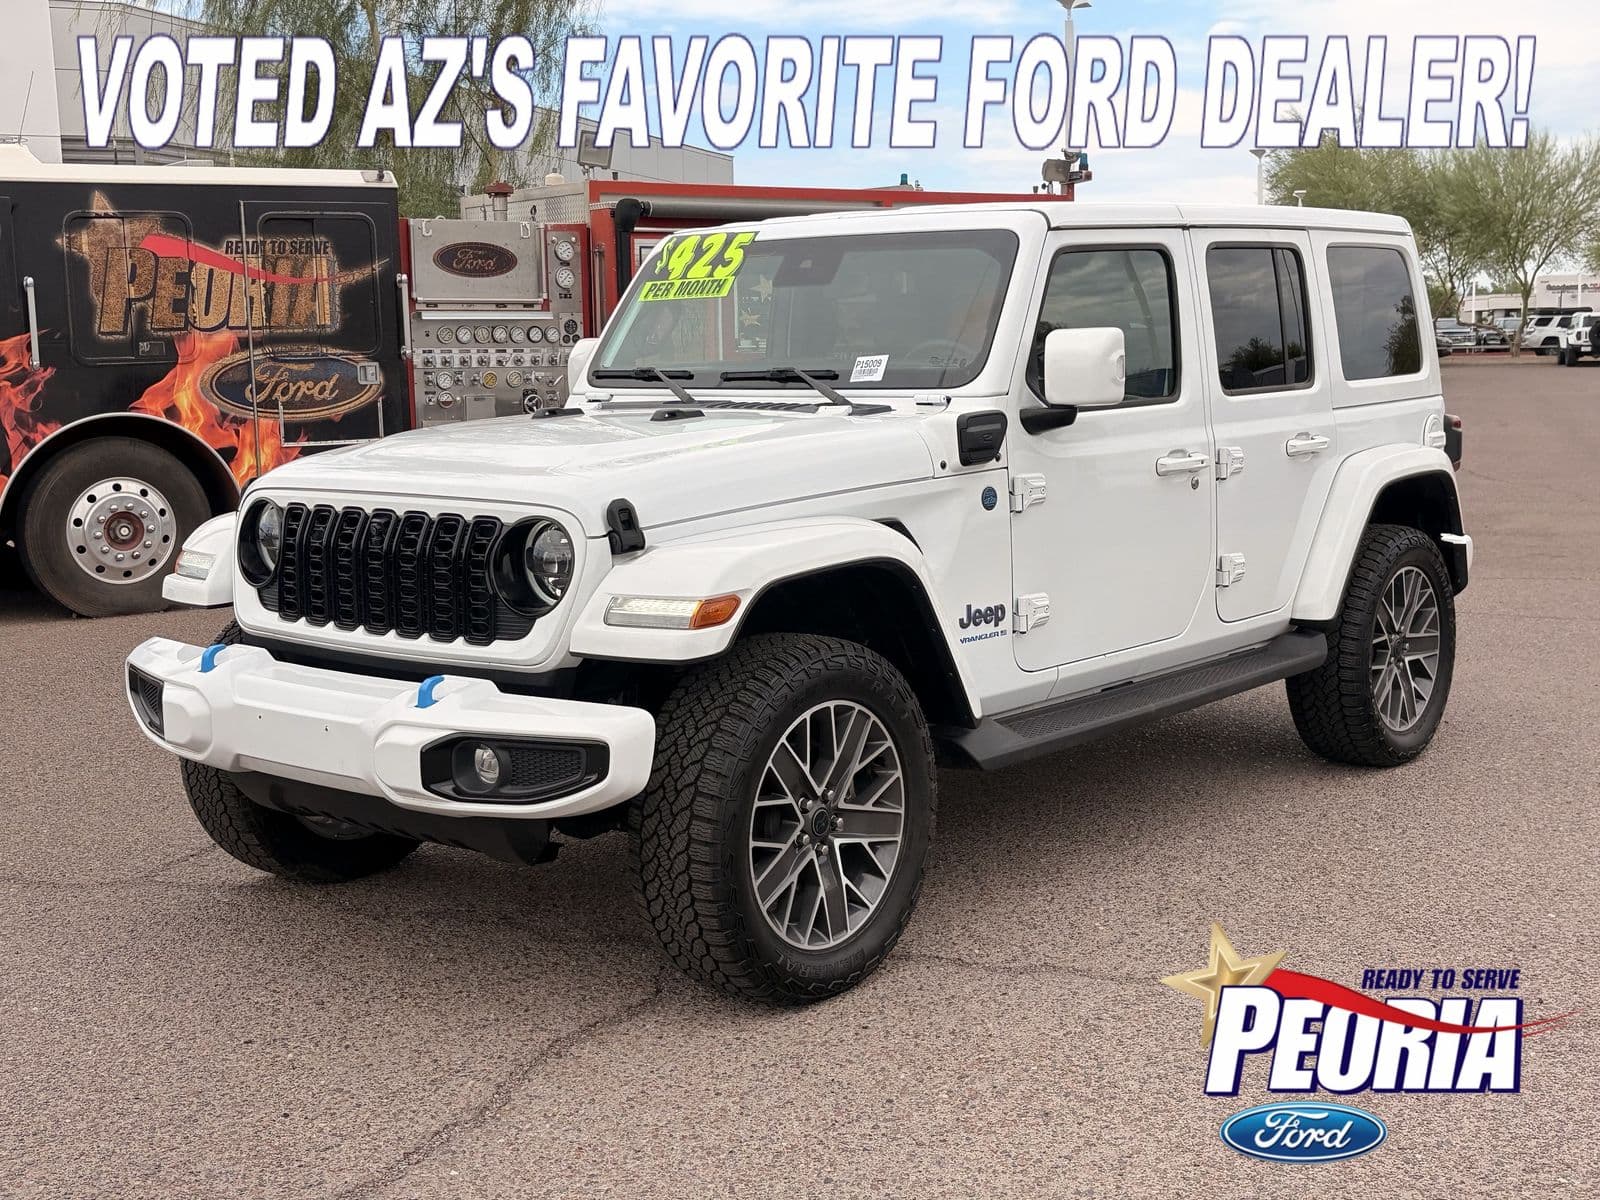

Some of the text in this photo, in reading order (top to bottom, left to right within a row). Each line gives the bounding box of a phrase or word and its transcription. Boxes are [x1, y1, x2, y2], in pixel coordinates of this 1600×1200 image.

[225, 240, 330, 255] READY TO SERVE
[653, 232, 756, 280] $425
[452, 248, 496, 271] Ford
[98, 247, 337, 335] PEORIA
[644, 279, 728, 298] PER MONTH
[856, 359, 882, 368] P15009
[244, 362, 340, 402] Ford
[959, 604, 1005, 629] Jeep
[959, 631, 999, 644] WRANGLER
